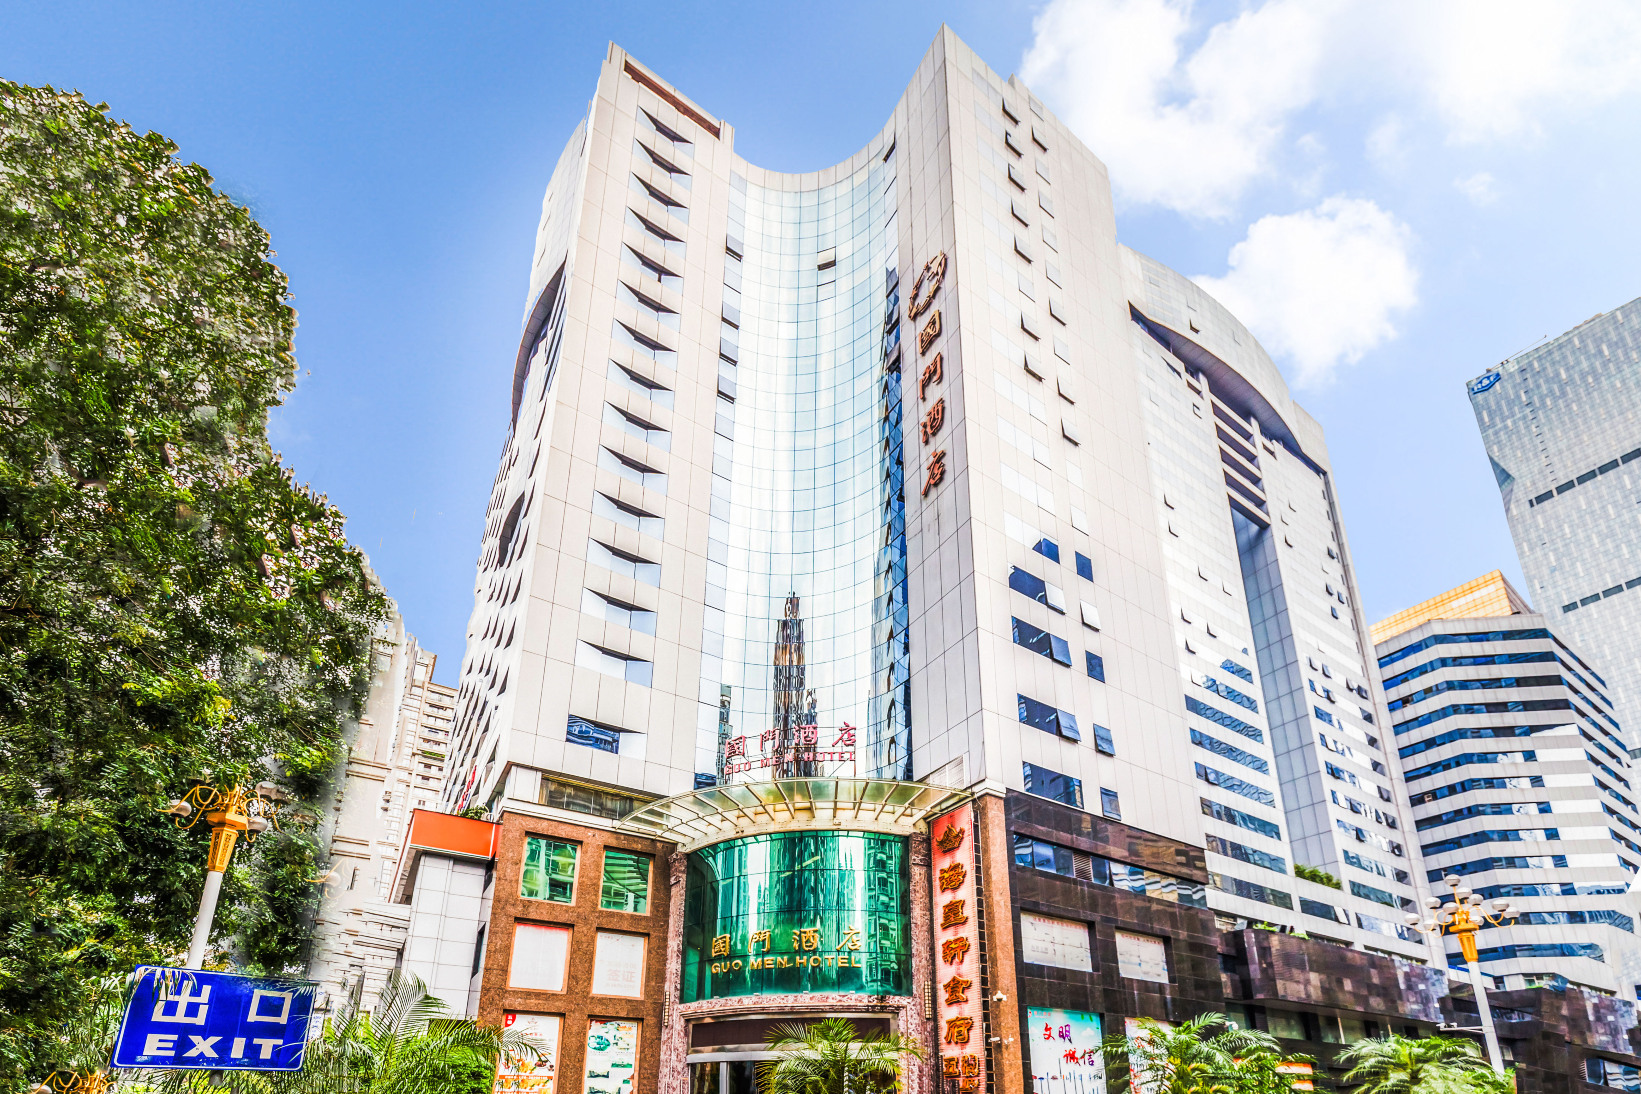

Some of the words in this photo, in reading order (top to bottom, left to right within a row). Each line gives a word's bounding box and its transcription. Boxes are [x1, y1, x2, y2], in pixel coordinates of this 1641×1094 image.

[919, 309, 945, 496] 國門酒店
[725, 721, 857, 758] 國門酒店
[724, 761, 752, 775] GUO
[760, 753, 793, 768] MEN
[804, 752, 856, 762] HOTEL
[711, 925, 862, 958] 國門酒店
[711, 960, 743, 974] GUO
[750, 956, 789, 970] MEN
[796, 955, 862, 968] HOTEL
[151, 979, 293, 1026] 出口
[142, 1033, 284, 1060] EXIT
[1042, 1022, 1073, 1043] 文明
